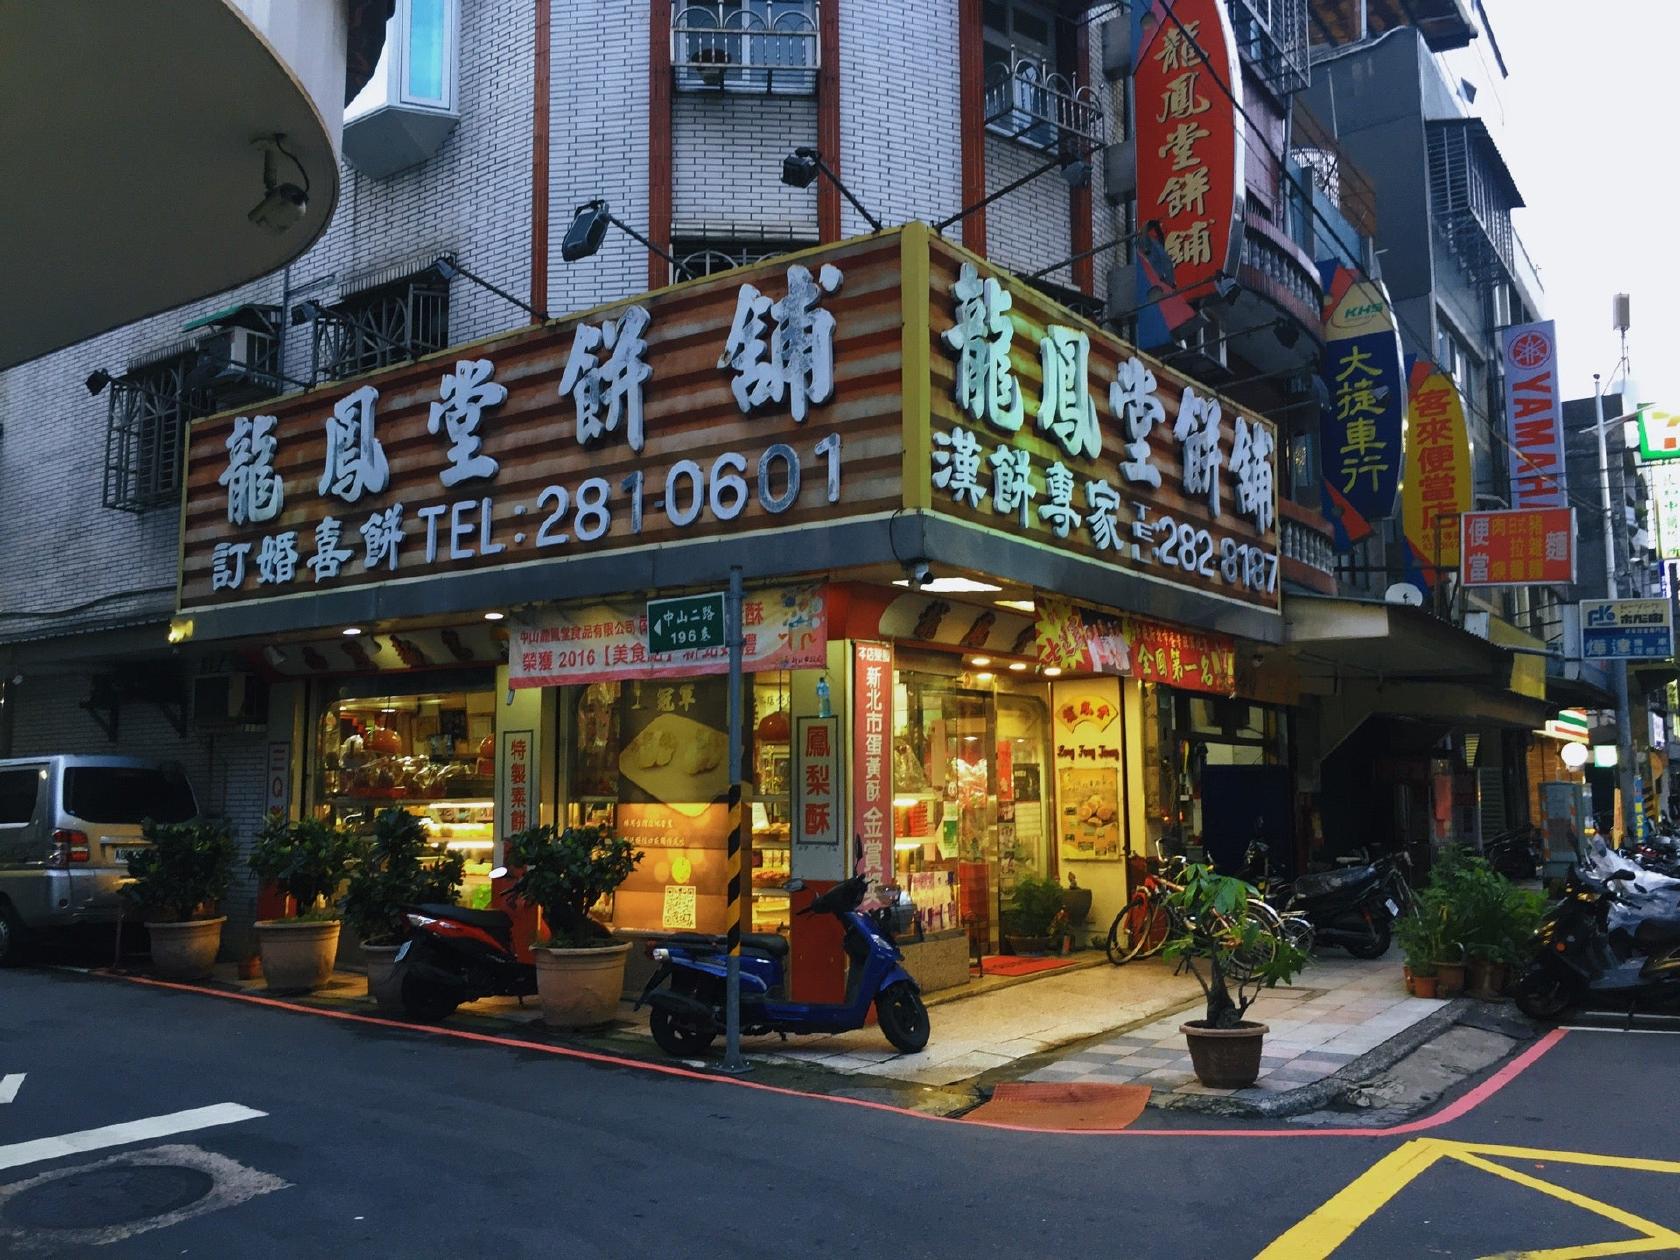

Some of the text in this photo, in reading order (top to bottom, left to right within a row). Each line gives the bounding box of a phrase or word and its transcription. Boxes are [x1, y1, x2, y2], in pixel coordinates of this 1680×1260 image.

[1344, 303, 1383, 318] KHS
[1336, 346, 1389, 494] 大捷車行
[1415, 389, 1458, 530] 客來便當店
[932, 426, 1125, 551] 漢餅專家
[211, 503, 407, 591] 訂婚喜餅
[1468, 517, 1489, 582] 便當
[523, 651, 553, 671] 榮獲
[559, 649, 595, 668] 2016
[663, 605, 715, 627] 中山二路
[511, 739, 526, 833] 特製素餅
[805, 726, 830, 836] 鳳梨酥
